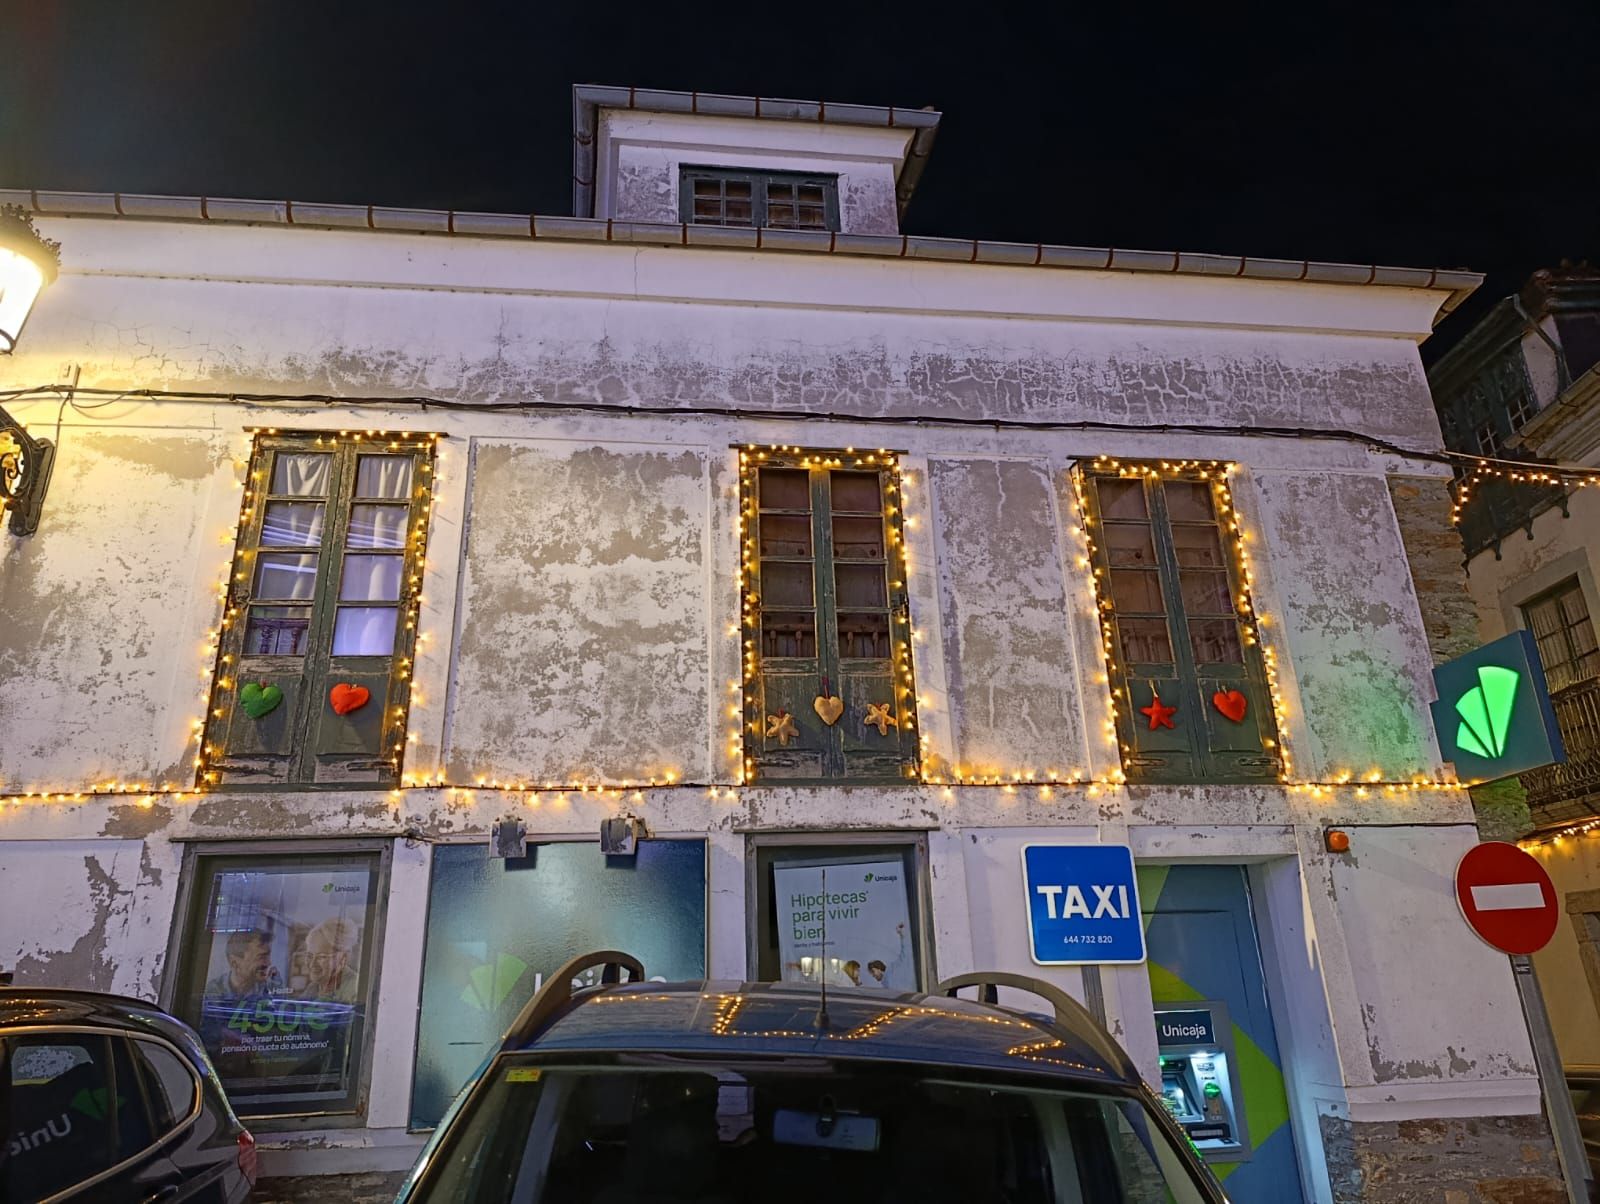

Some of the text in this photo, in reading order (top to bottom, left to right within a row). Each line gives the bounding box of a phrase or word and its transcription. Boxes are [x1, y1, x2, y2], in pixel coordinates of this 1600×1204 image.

[875, 875, 898, 883] Unicaja
[335, 885, 360, 893] Unicaja
[1037, 885, 1130, 919] TAXI
[792, 906, 860, 926] para vivir
[793, 926, 825, 940] bien
[1063, 935, 1113, 944] 644 732 820
[228, 999, 329, 1033] 450€
[1162, 1024, 1207, 1038] Unicaja
[241, 1037, 255, 1045] por
[256, 1035, 273, 1043] traer
[221, 1046, 251, 1055] pensión
[258, 1043, 279, 1051] cuota
[280, 1042, 290, 1050] de
